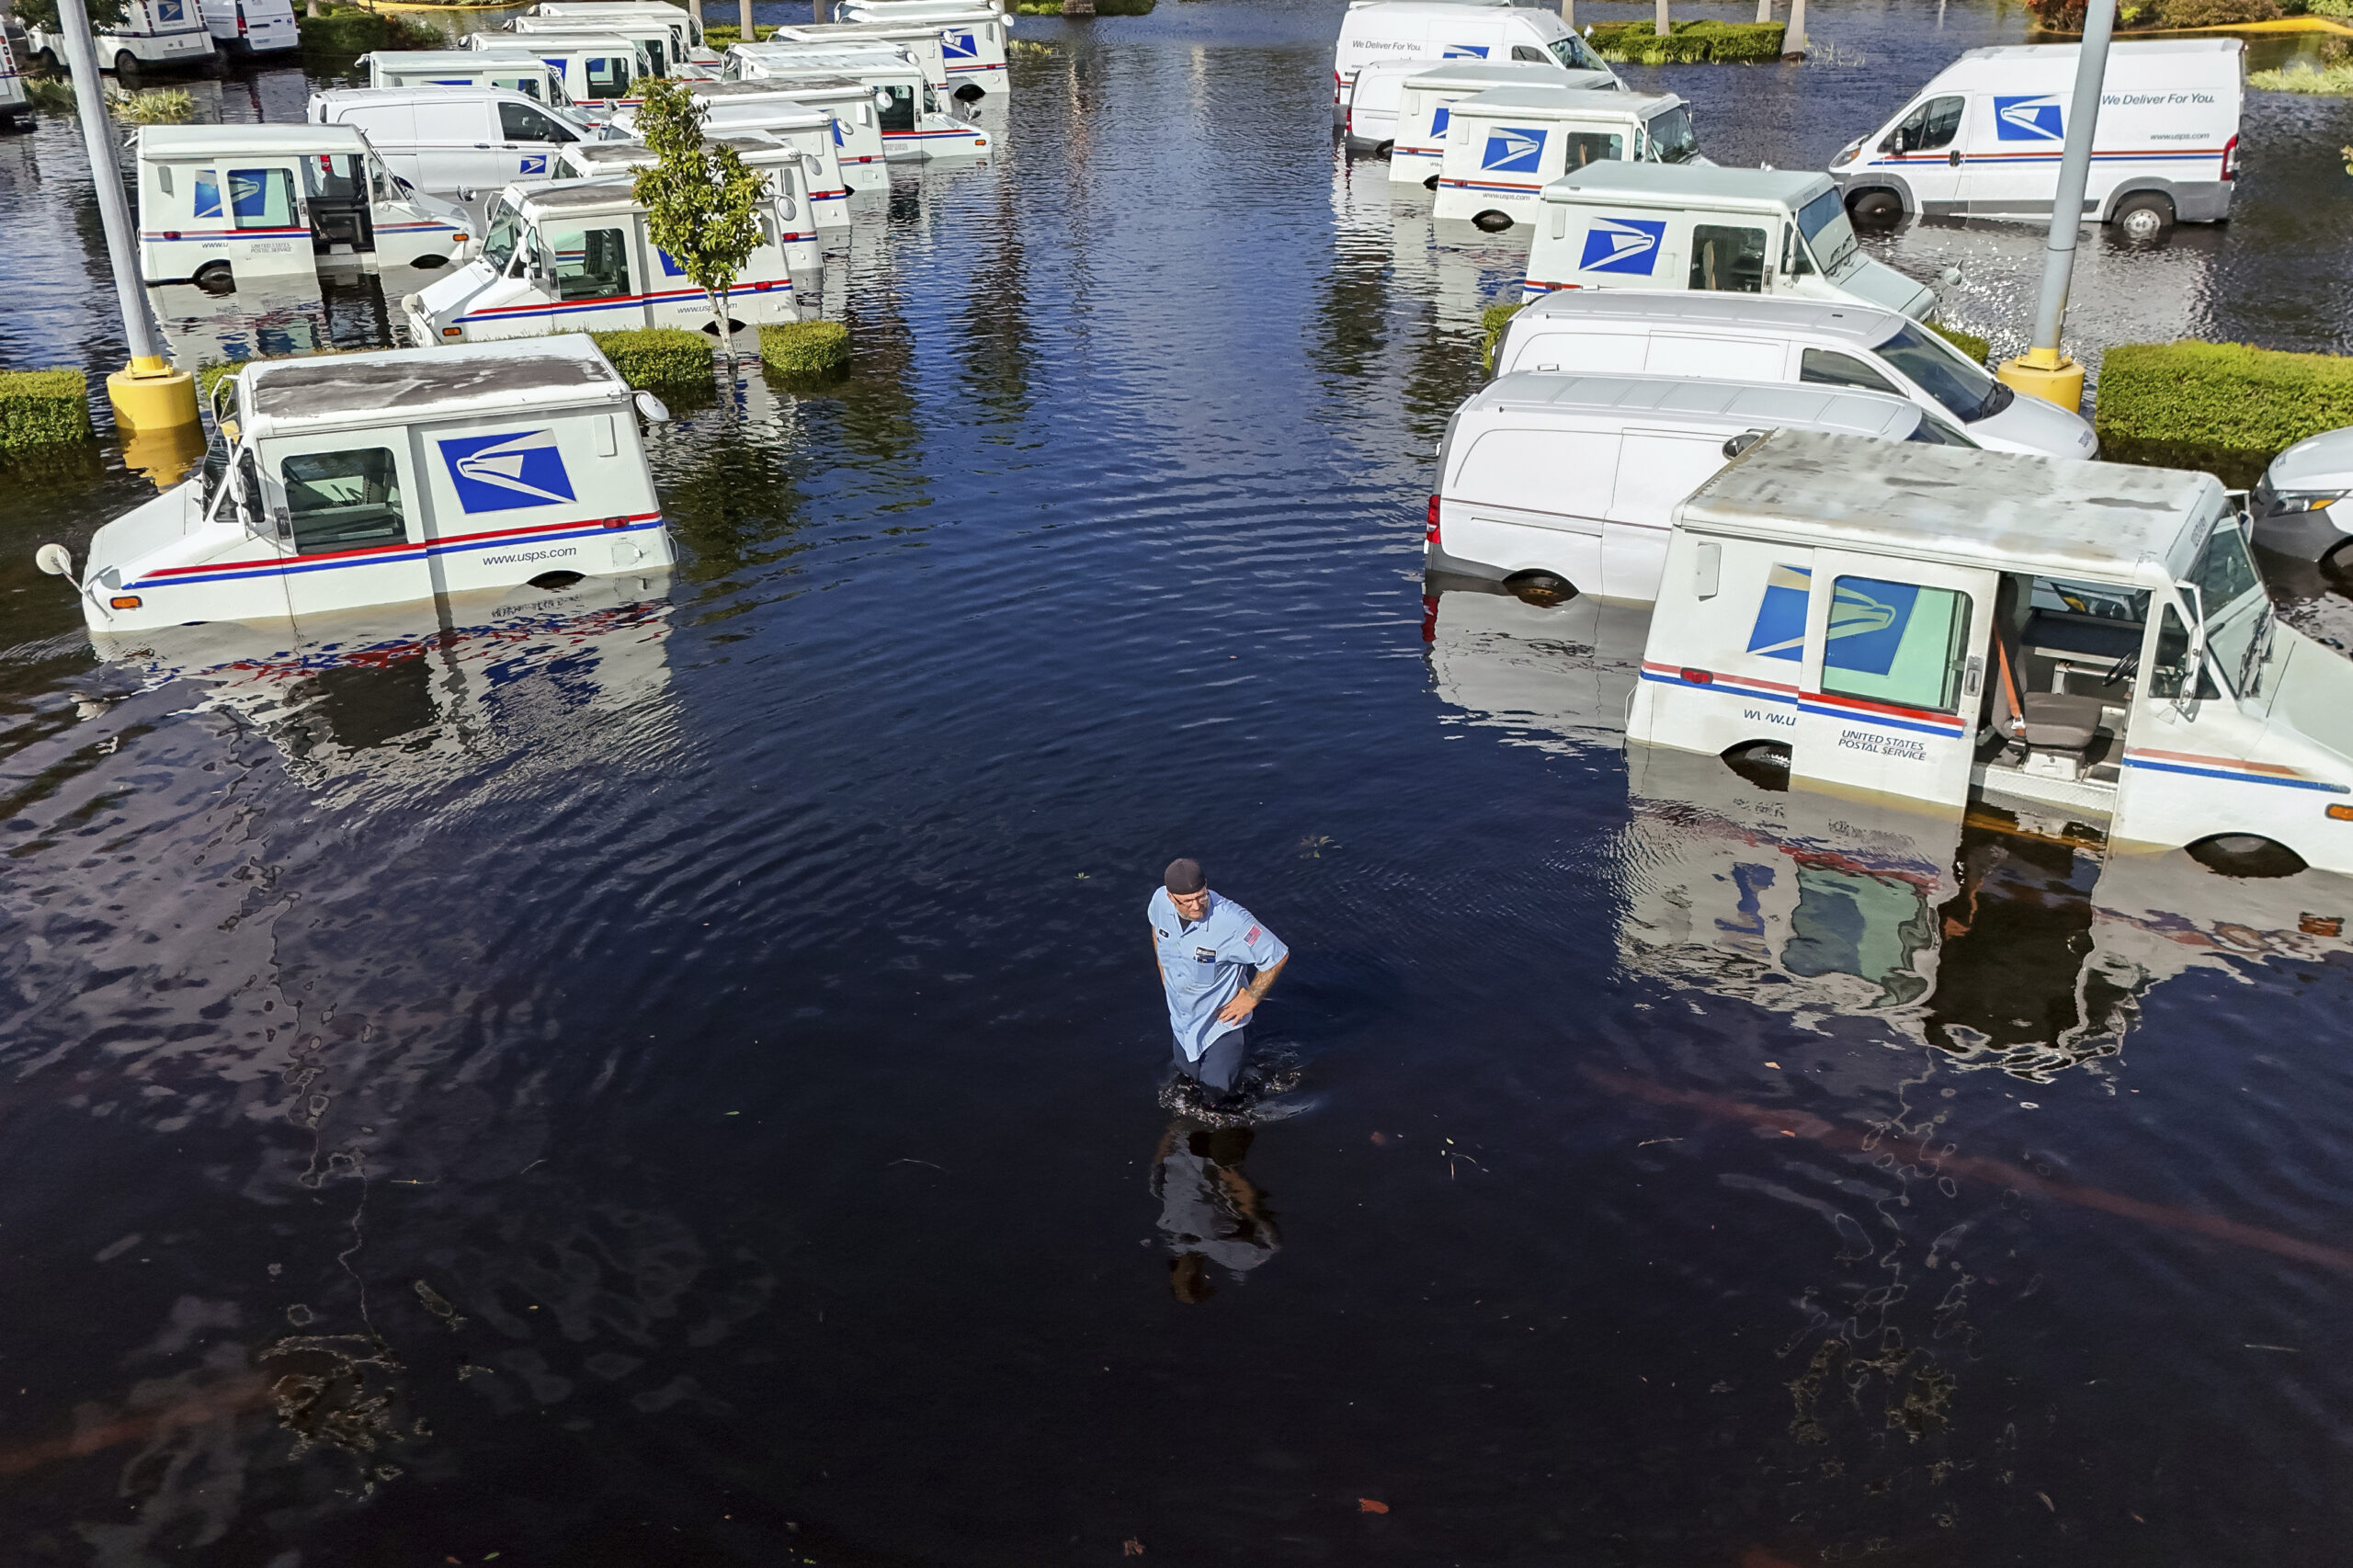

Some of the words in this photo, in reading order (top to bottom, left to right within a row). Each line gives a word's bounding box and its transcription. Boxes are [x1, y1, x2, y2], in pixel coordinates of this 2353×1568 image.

[1352, 40, 1364, 49] We
[1365, 41, 1391, 50] Deliver
[2102, 95, 2120, 105] We
[2122, 95, 2165, 105] Deliver
[2167, 94, 2189, 104] For
[2191, 93, 2215, 103] You.
[1483, 193, 1530, 201] www.usps.com
[483, 547, 577, 565] www.usps.com
[1842, 730, 1884, 744] UNITED
[1886, 736, 1926, 751] STATES
[1837, 738, 1879, 754] POSTAL
[1882, 745, 1927, 761] SERVICE
